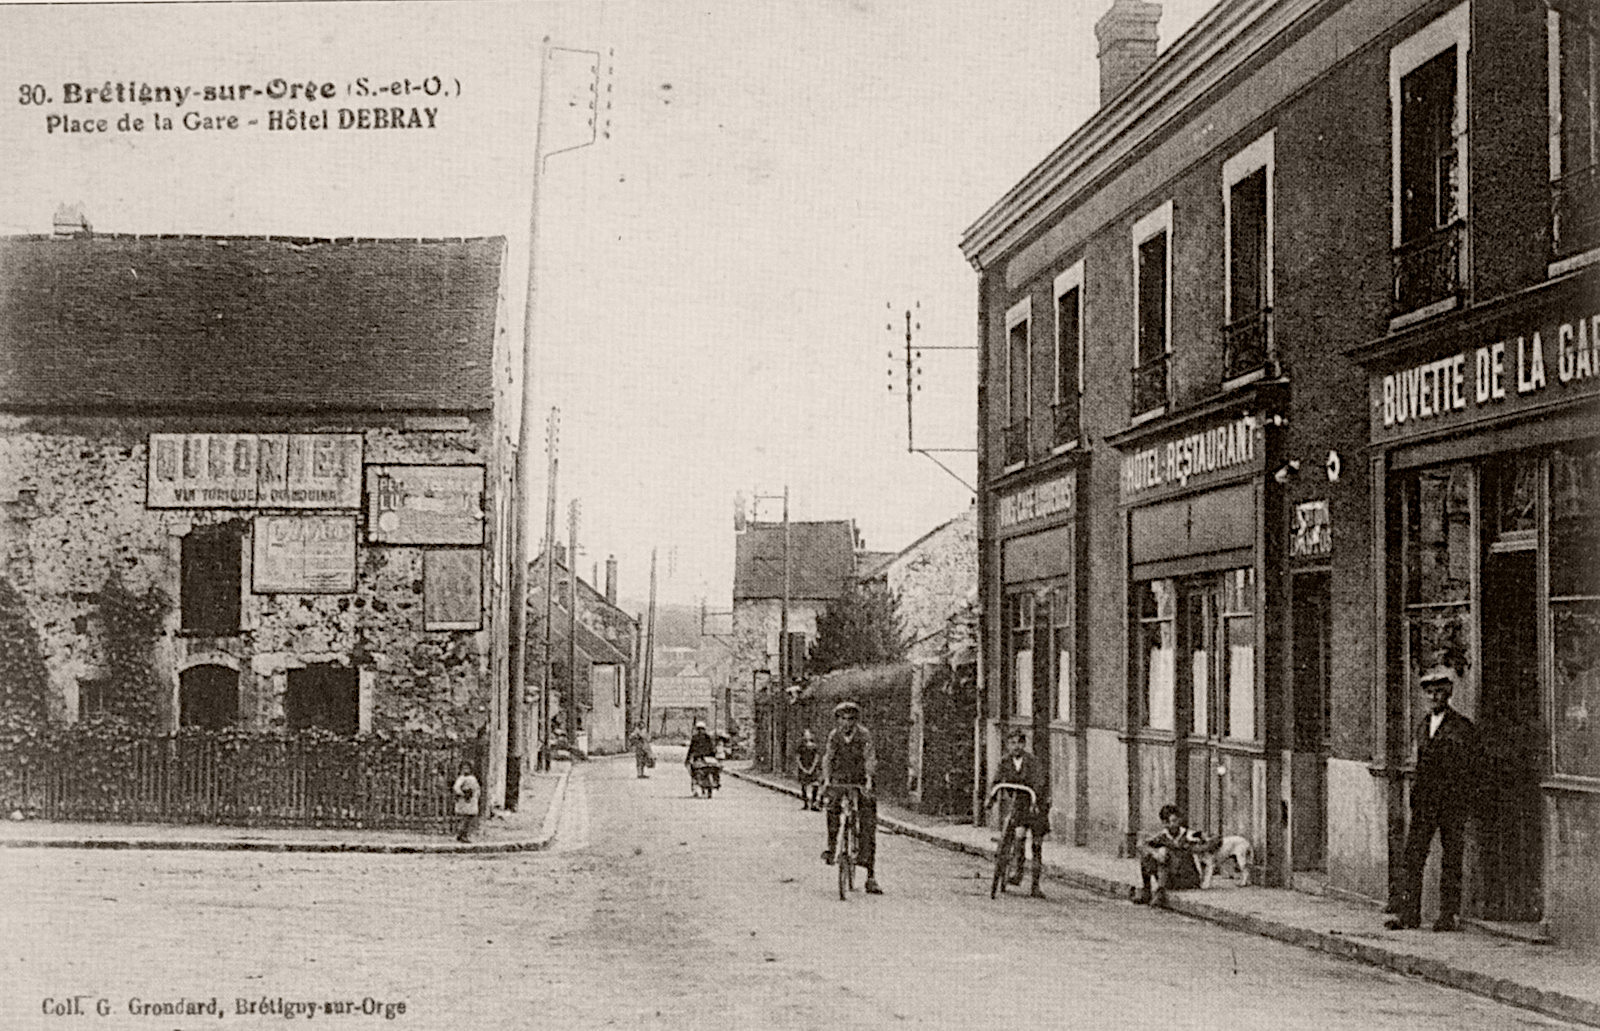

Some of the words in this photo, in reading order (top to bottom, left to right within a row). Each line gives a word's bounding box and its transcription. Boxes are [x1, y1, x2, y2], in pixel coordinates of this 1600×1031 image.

[1384, 354, 1467, 426] BUVETTE
[1476, 342, 1506, 404] DE
[1518, 331, 1547, 394] LA
